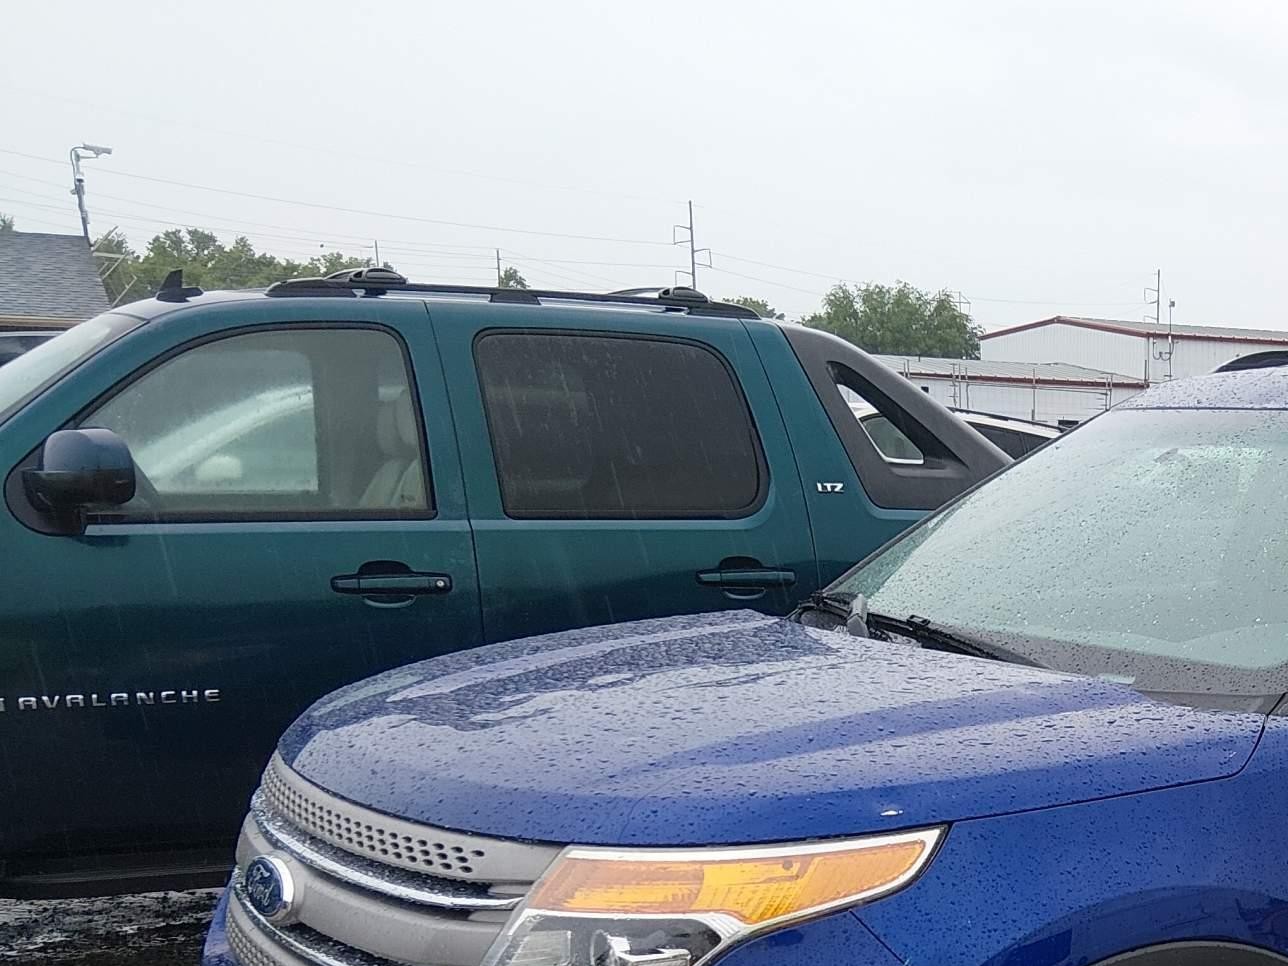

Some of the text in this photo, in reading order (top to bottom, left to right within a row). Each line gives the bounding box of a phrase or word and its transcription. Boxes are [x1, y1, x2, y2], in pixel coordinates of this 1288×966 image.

[816, 482, 845, 493] LTZ
[17, 689, 221, 710] AVALANCHE
[248, 864, 275, 906] Ford
